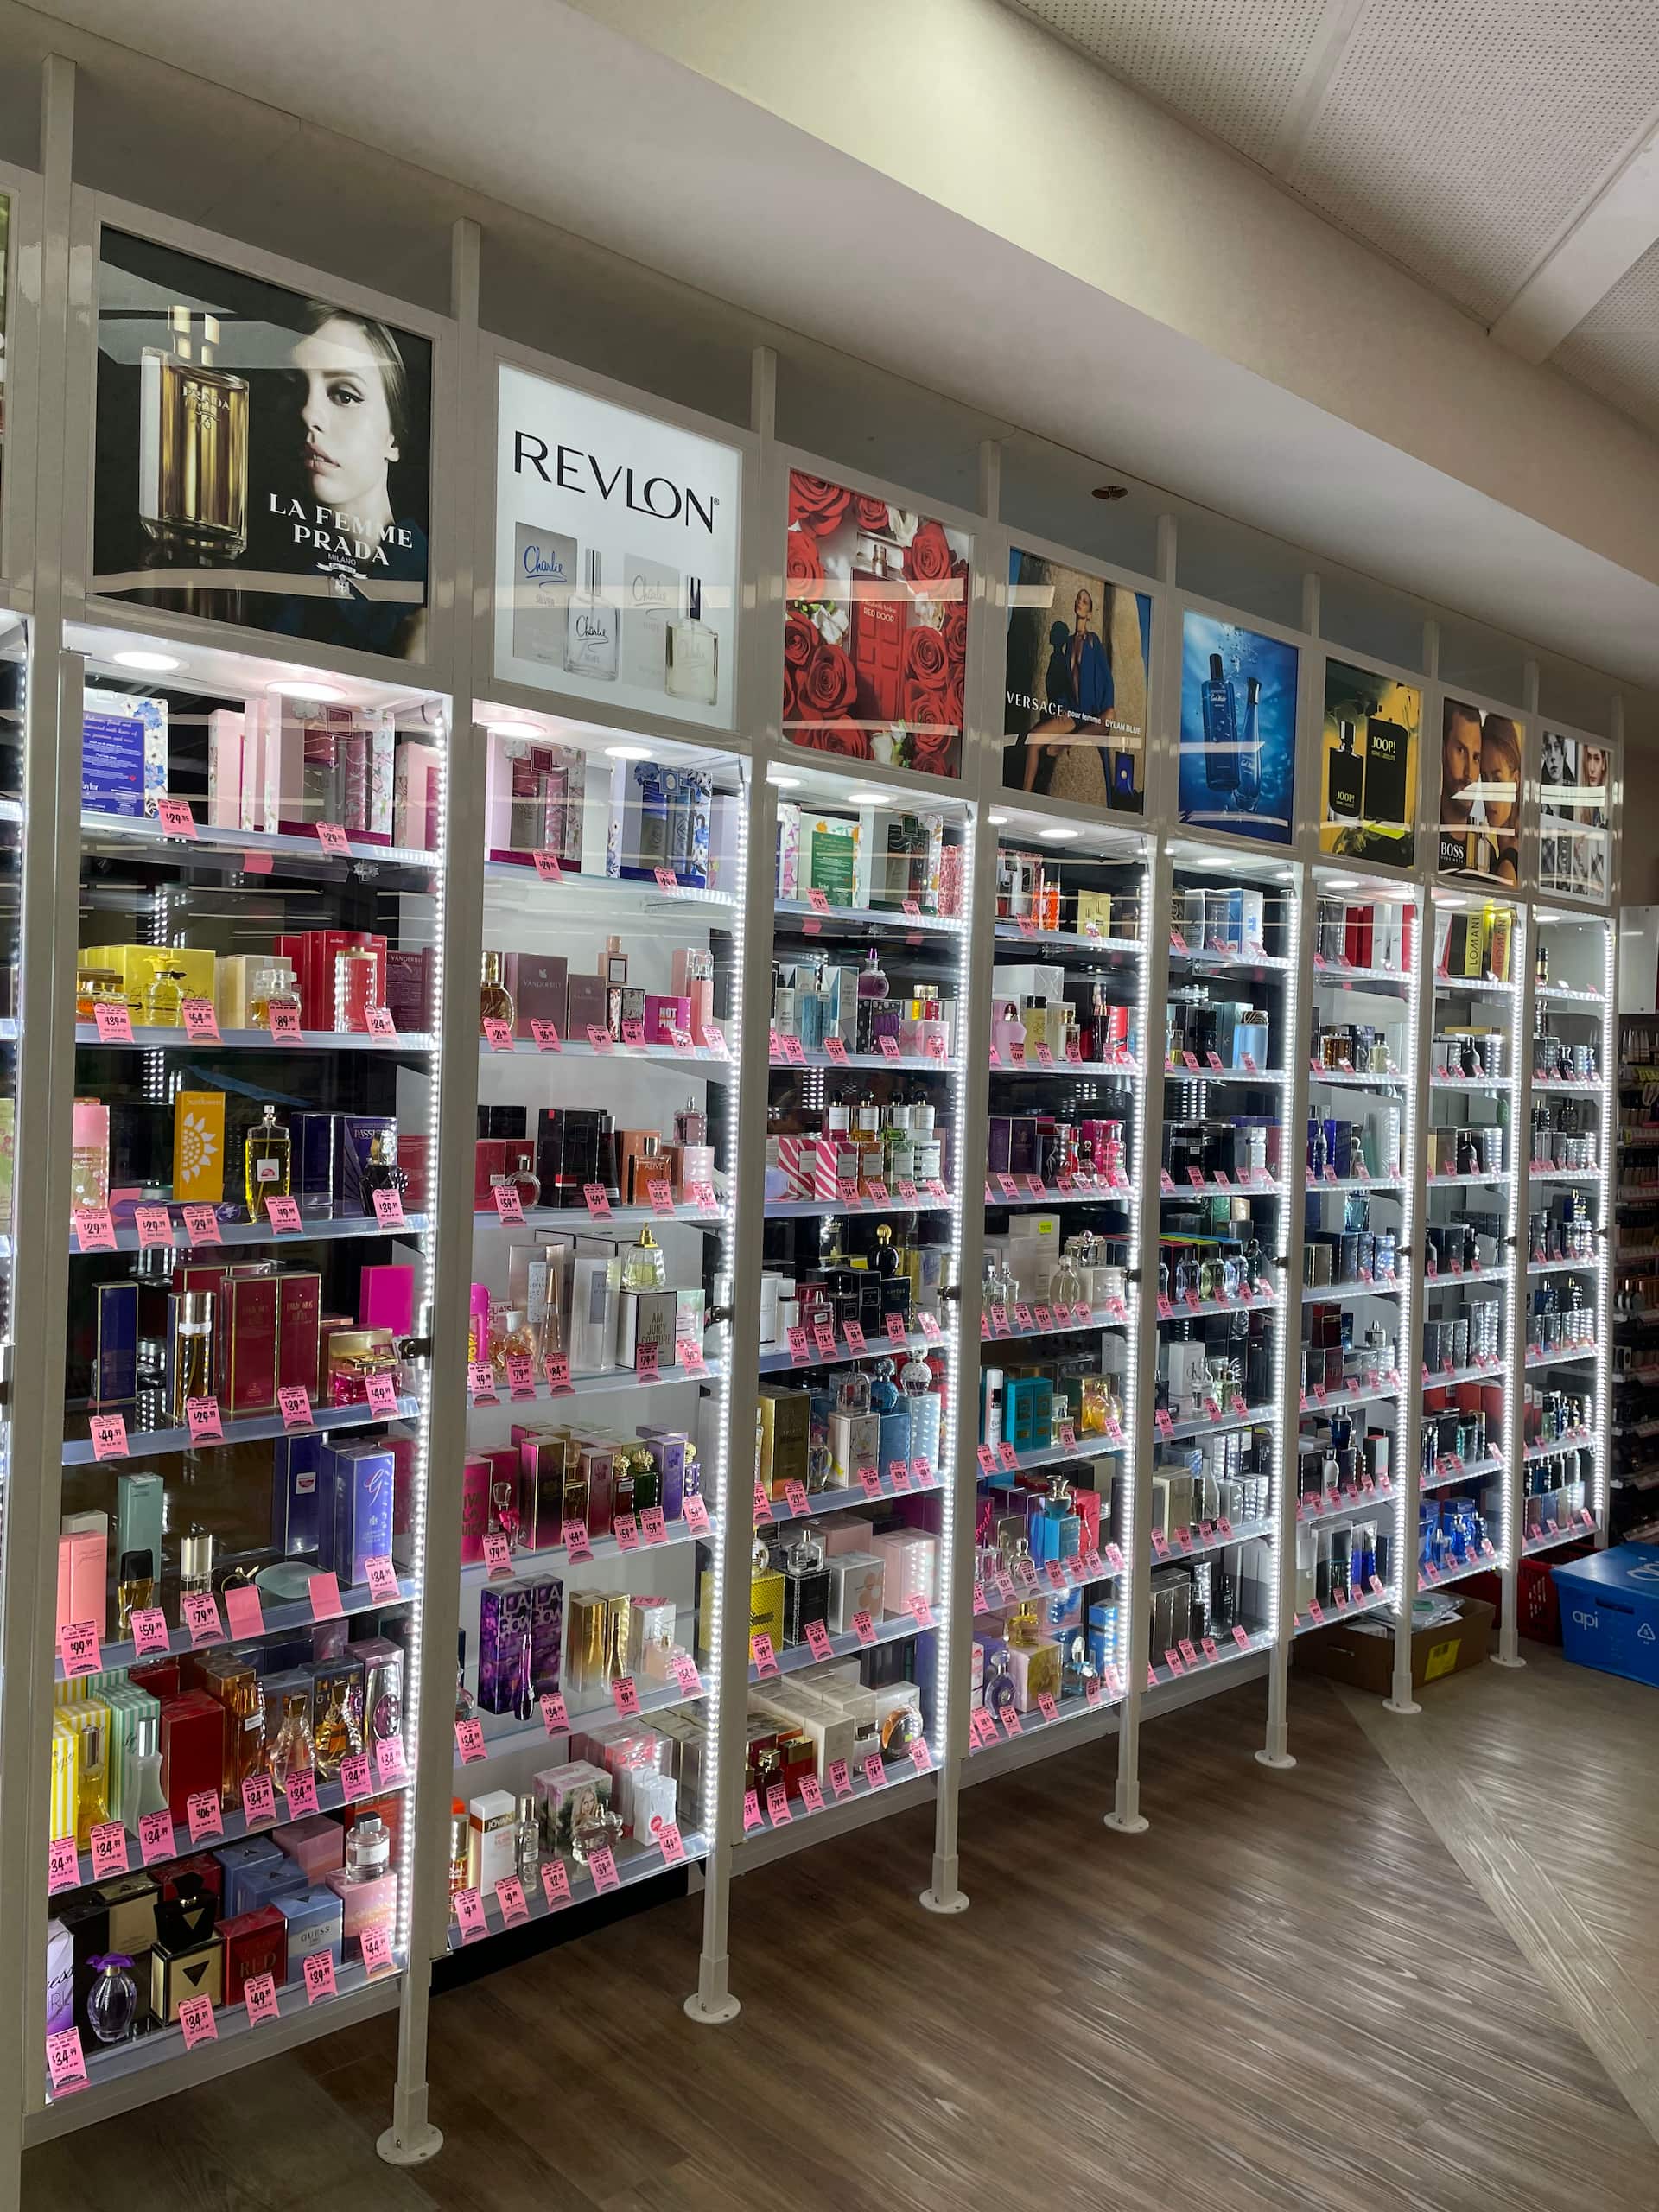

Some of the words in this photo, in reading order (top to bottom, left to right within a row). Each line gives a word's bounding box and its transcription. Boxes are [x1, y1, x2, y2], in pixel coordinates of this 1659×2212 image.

[270, 493, 307, 520] LA
[315, 505, 414, 549] FEMME
[293, 524, 390, 566] PRADA
[328, 552, 357, 566] MILANO
[524, 545, 565, 574] Charlie
[863, 607, 875, 618] RED
[876, 611, 894, 623] DOOR
[575, 615, 607, 638] Charlie
[1007, 691, 1064, 717] VERSACE
[1067, 709, 1081, 720] pour
[1082, 712, 1102, 725] femme
[1105, 719, 1125, 732] DYLAN
[1126, 723, 1141, 735] BLUE
[1371, 735, 1396, 754] JOOP!
[1336, 791, 1355, 804] JOOP!
[1440, 842, 1465, 860] BOSS
[1470, 917, 1480, 966] LOMANI
[659, 1007, 677, 1018] HOT
[84, 1223, 107, 1235] $29.99
[143, 1219, 166, 1232] $29.99
[191, 1218, 213, 1231] $29.99
[652, 1313, 664, 1323] AM
[647, 1324, 666, 1335] JUICY
[194, 1410, 216, 1424] $29.99
[193, 1608, 214, 1624] $79.99
[1573, 1610, 1599, 1631] api
[139, 1622, 162, 1637] $59.99
[144, 1827, 168, 1845] $34.99
[97, 1840, 121, 1857] $34.99
[50, 1855, 73, 1873] 34.99
[300, 1926, 331, 1942] GUESS
[186, 2010, 208, 2029] $34.99
[52, 2047, 77, 2067] $34.99
